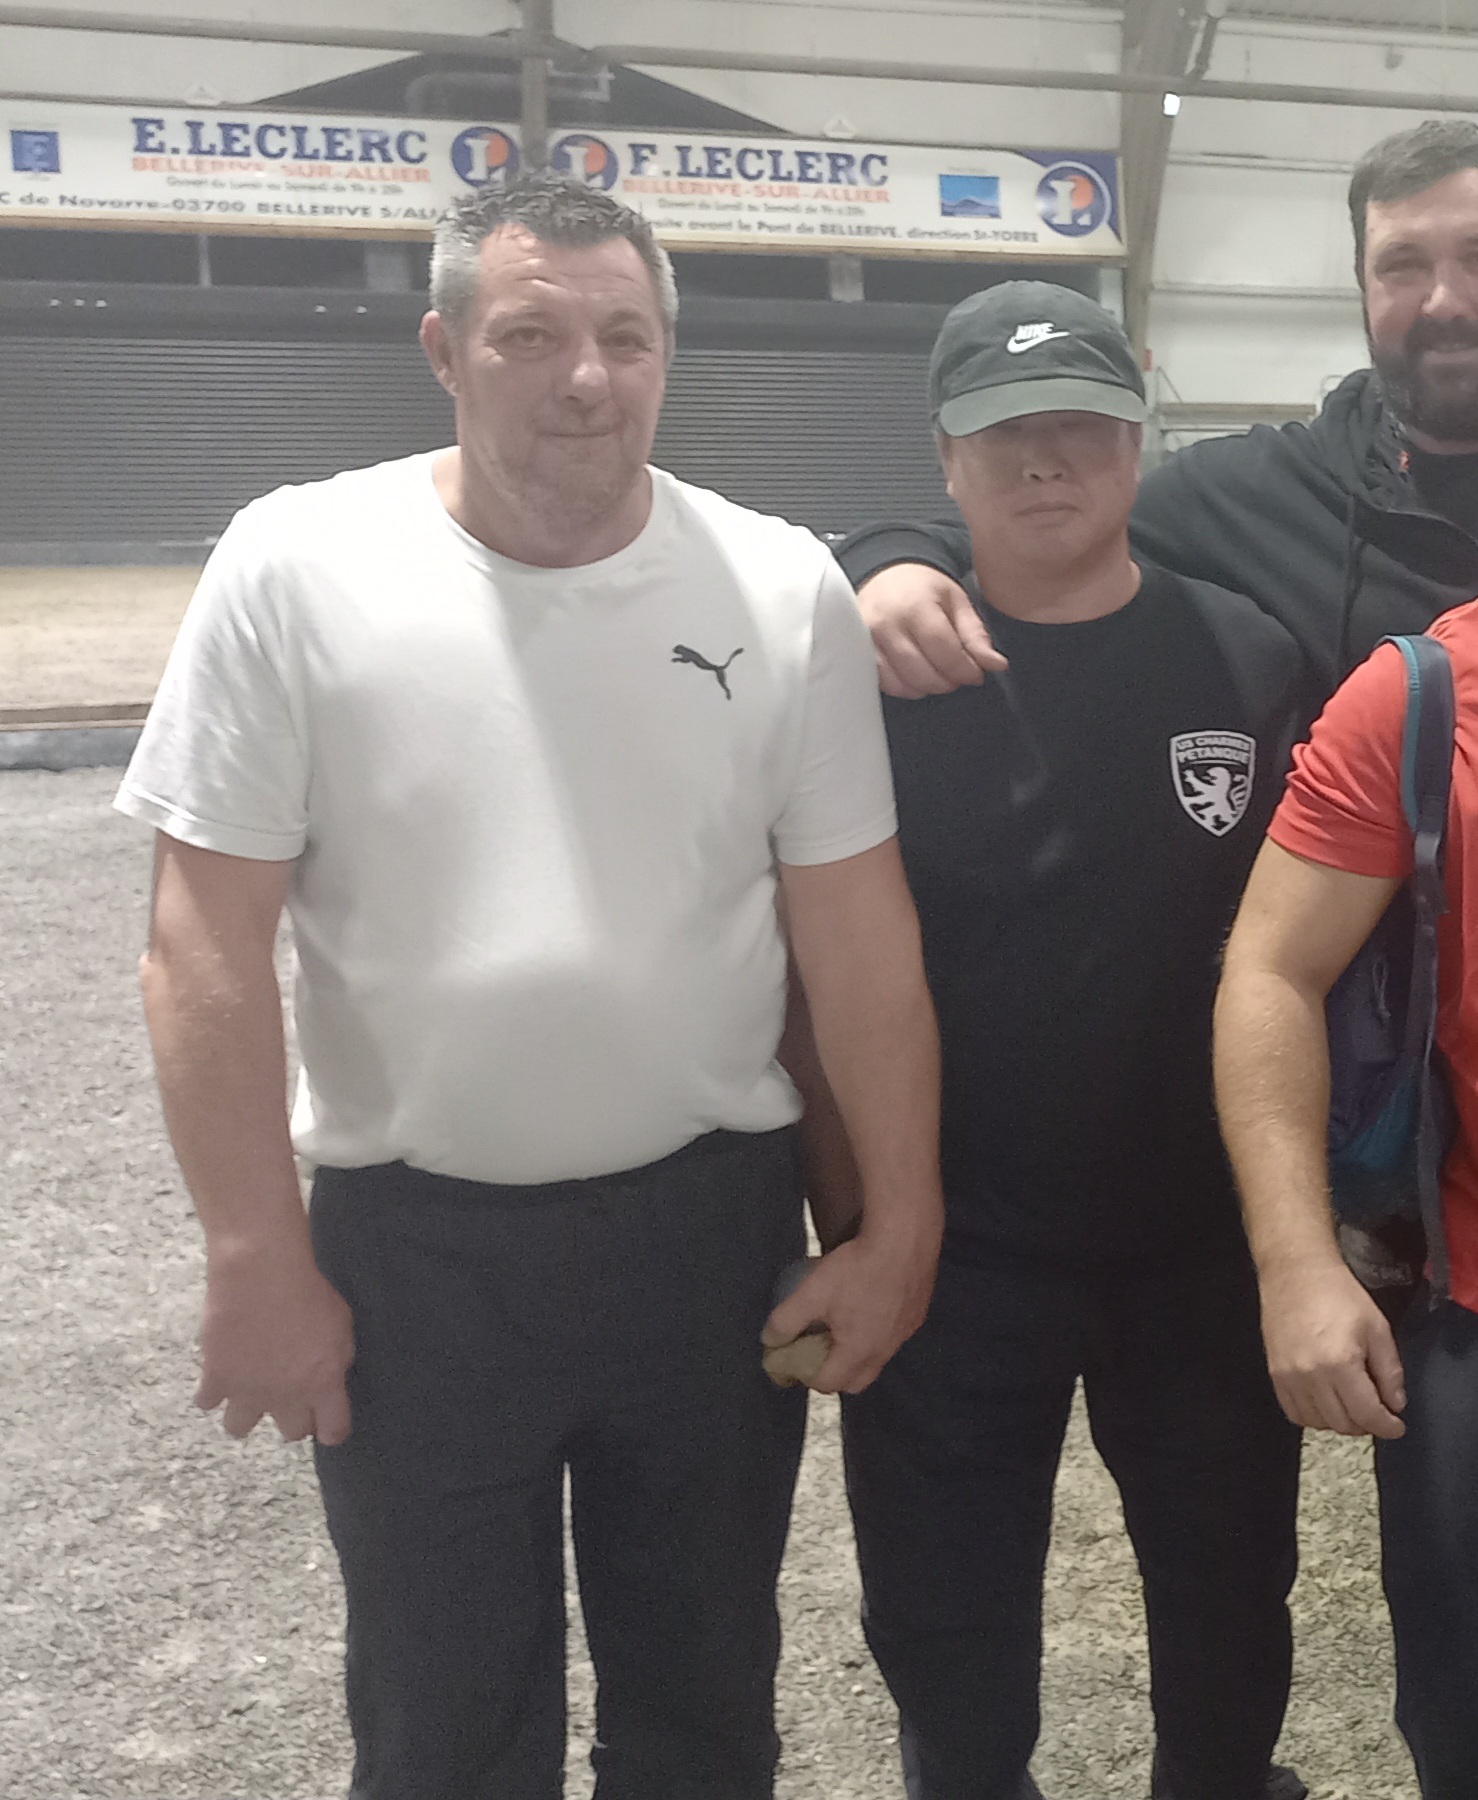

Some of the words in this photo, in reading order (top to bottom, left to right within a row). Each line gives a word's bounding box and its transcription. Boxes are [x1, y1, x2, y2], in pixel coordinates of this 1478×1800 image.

[131, 118, 428, 164] E.LECLERC
[19, 190, 50, 205] de
[257, 201, 372, 217] BELLERIVE
